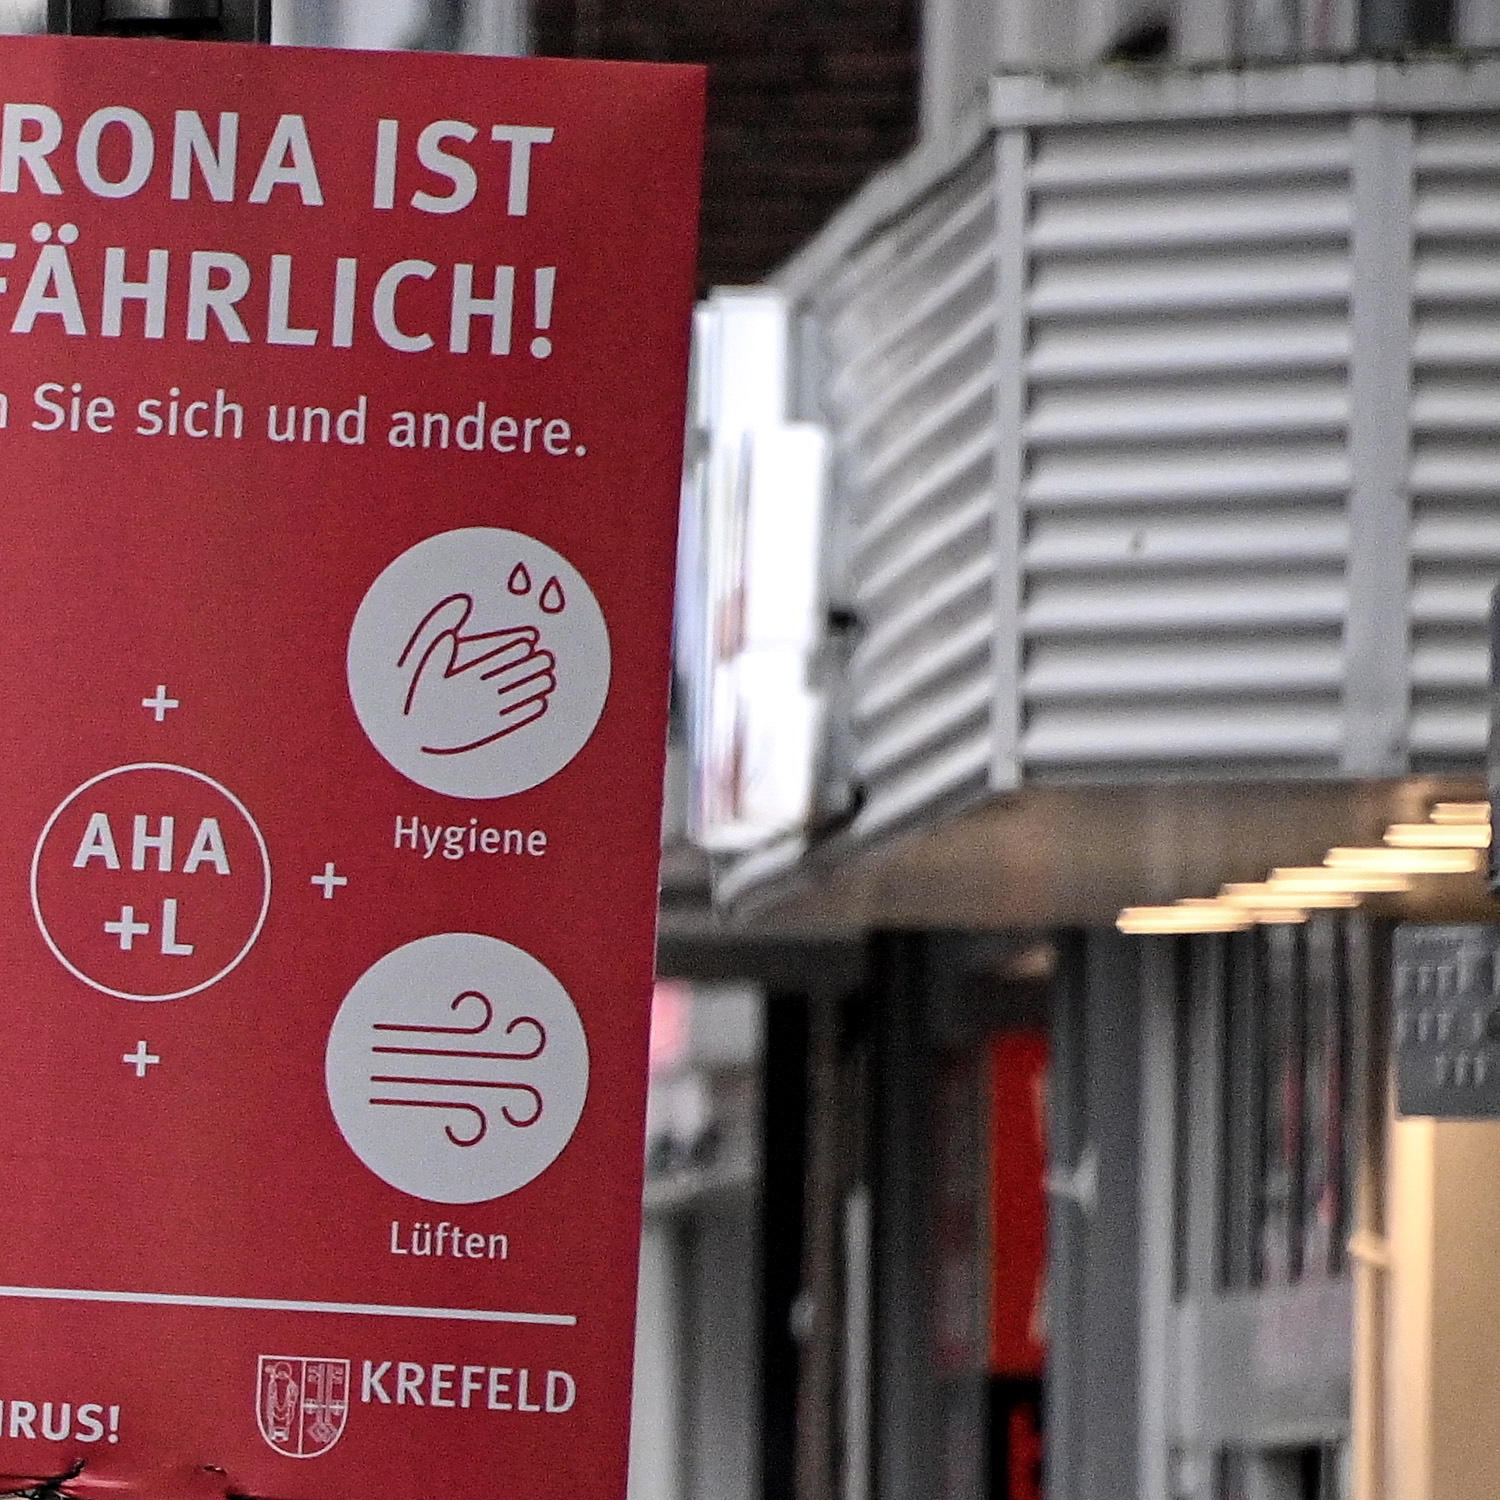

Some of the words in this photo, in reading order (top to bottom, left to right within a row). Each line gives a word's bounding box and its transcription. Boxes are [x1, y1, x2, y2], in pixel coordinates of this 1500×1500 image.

[374, 120, 554, 215] IST
[32, 383, 115, 434] Sie
[137, 388, 243, 438] sich
[268, 396, 367, 446] und
[388, 402, 588, 457] andere.
[73, 812, 231, 875] AHA
[395, 815, 547, 858] Hygiene
[390, 1221, 508, 1261] Lüften
[361, 1360, 576, 1413] KREFELD
